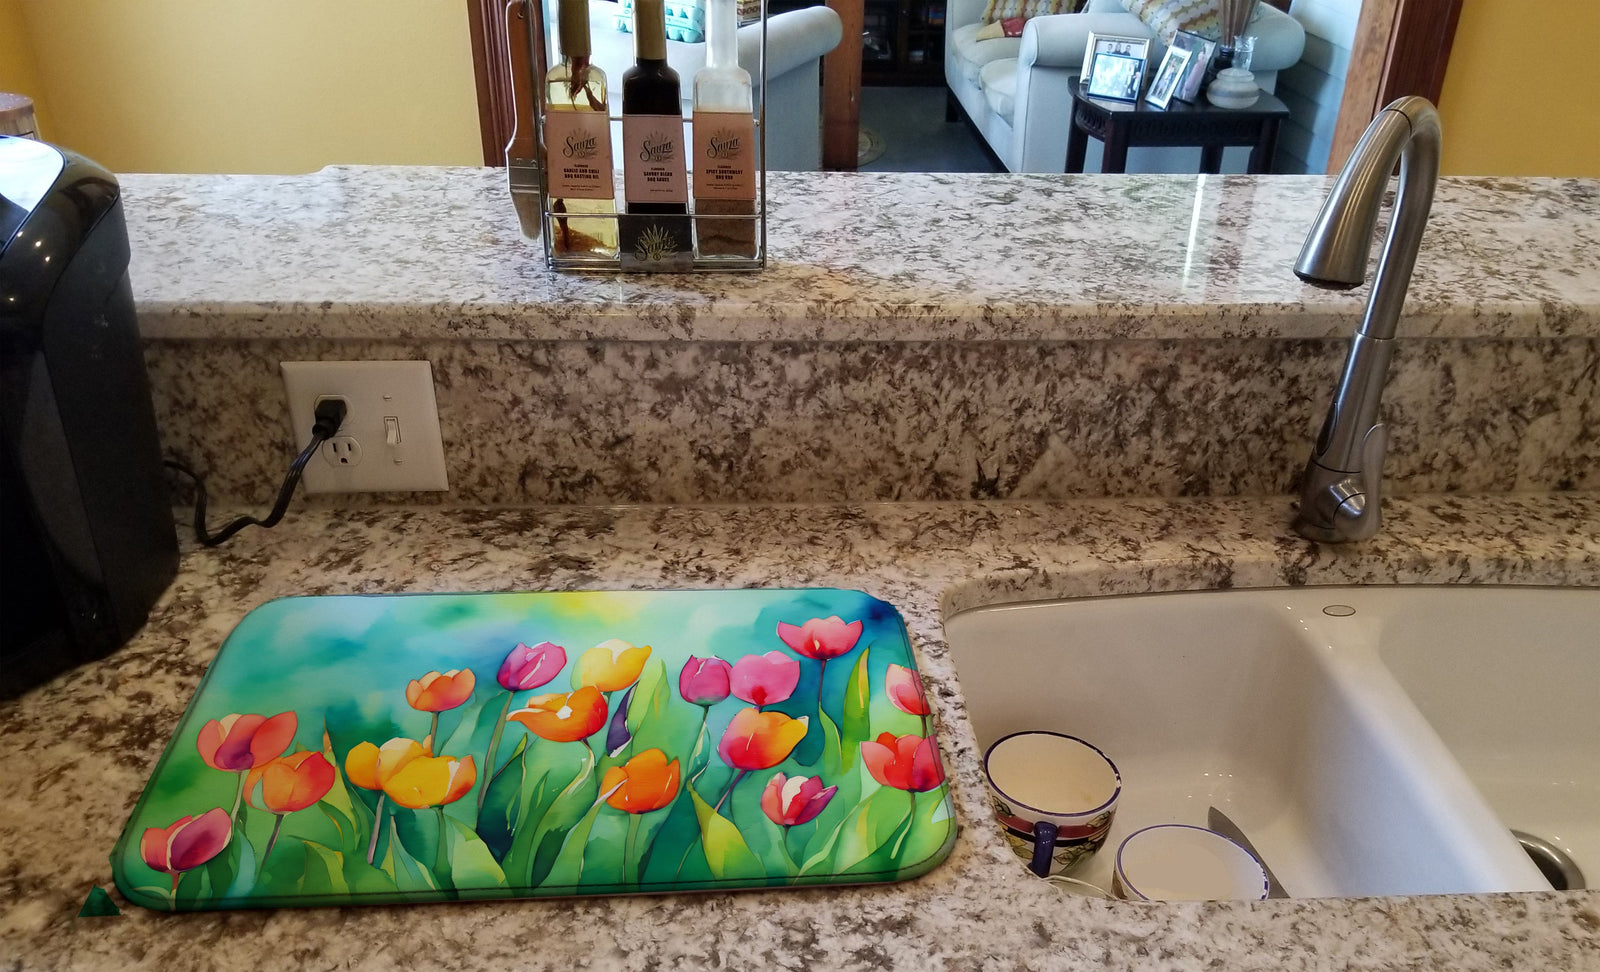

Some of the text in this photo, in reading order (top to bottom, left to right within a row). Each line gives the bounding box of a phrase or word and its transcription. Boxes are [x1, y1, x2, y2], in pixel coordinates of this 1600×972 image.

[562, 136, 598, 158] Sauza
[640, 140, 674, 162] Sauza
[706, 136, 740, 159] Sauza
